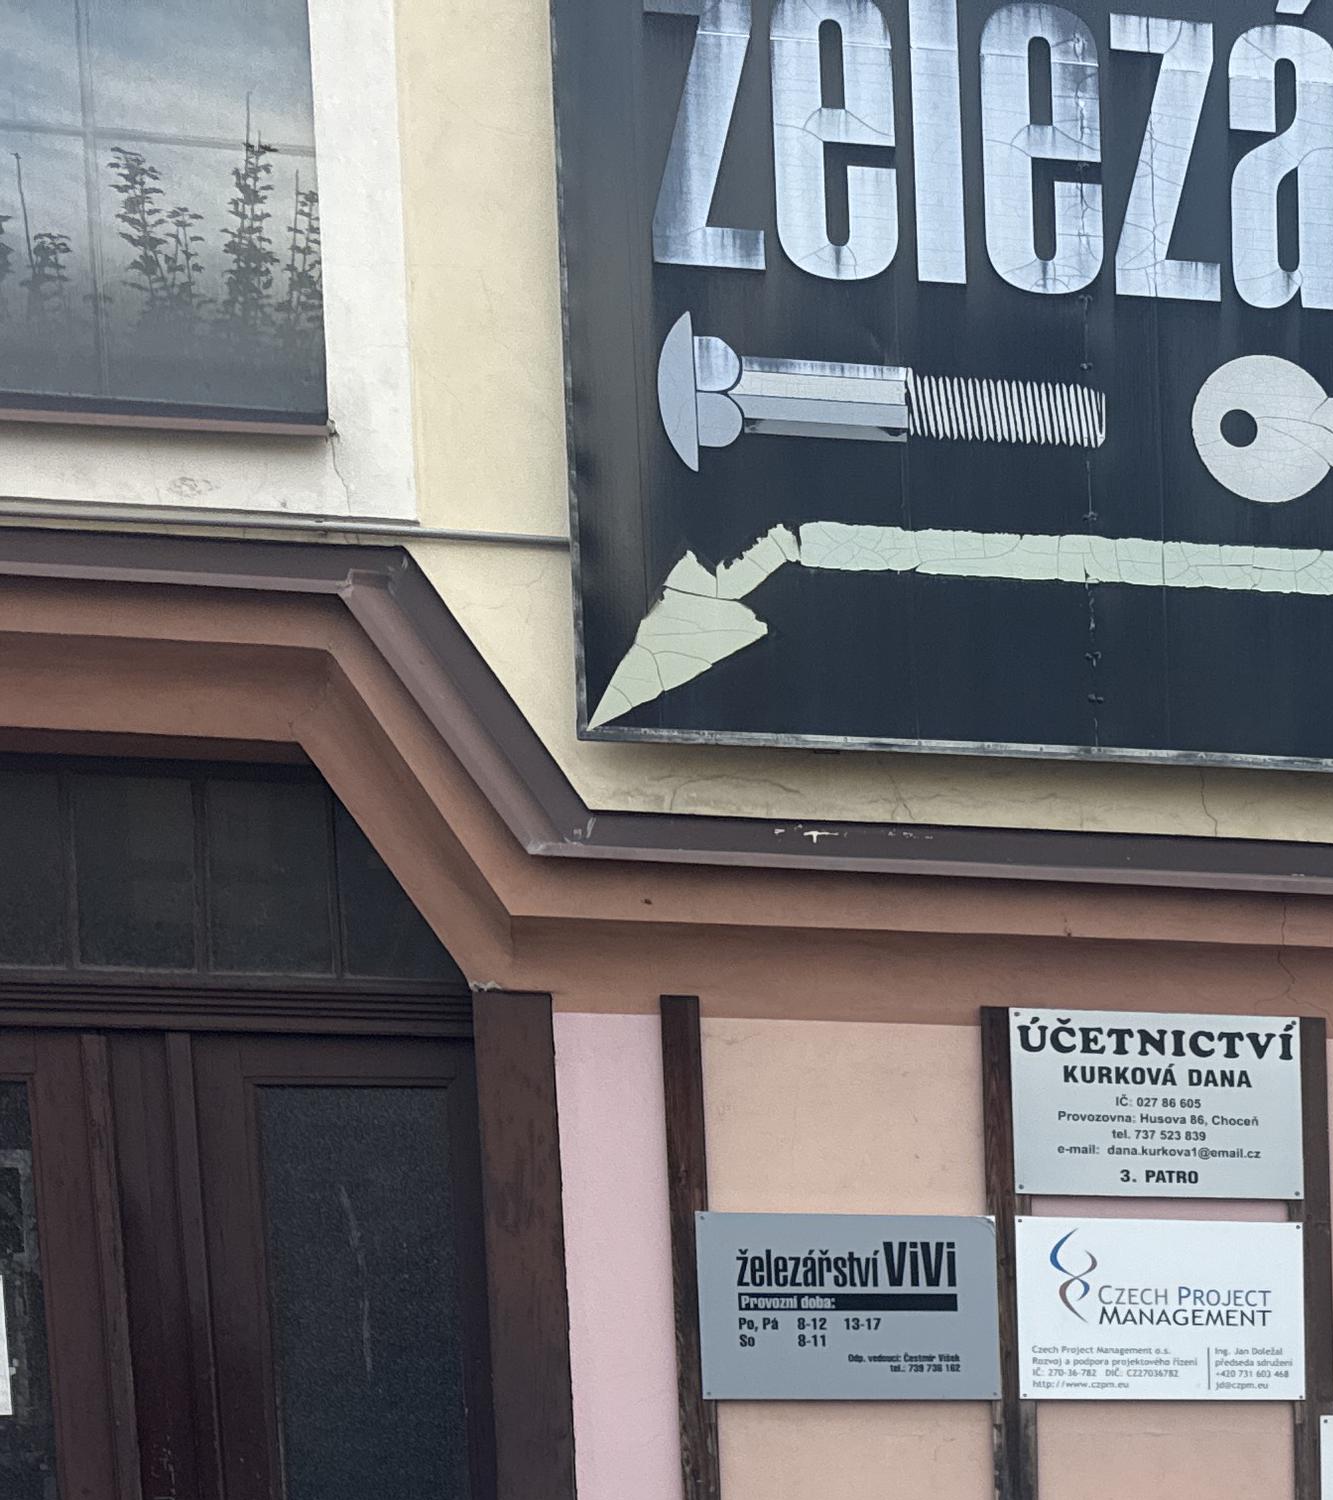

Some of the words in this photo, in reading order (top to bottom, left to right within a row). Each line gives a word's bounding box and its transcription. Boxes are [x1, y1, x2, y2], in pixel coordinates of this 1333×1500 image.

[1017, 1016, 1294, 1061] ÚČETNICTVÍ
[1063, 1063, 1178, 1087] KURKOVÁ
[1188, 1069, 1252, 1088] DANA
[1115, 1096, 1133, 1108] IČ:
[1136, 1097, 1158, 1109] 027
[1161, 1098, 1176, 1109] 86
[1179, 1098, 1202, 1109] 605
[1057, 1111, 1136, 1124] Provozovna:
[1140, 1113, 1187, 1126] Husova
[1190, 1115, 1208, 1128] 86,
[1211, 1113, 1260, 1127] Choceň
[1112, 1129, 1131, 1140] tel.
[1134, 1130, 1156, 1141] 737
[1159, 1130, 1182, 1141] 523
[1185, 1130, 1206, 1142] 839
[1057, 1144, 1100, 1155] e-mail:
[1107, 1145, 1262, 1160] dana.kurkova1@email.cz
[1120, 1169, 1137, 1184] 3.
[1145, 1170, 1200, 1184] PATRO
[736, 1249, 879, 1288] železářství
[882, 1241, 957, 1288] ViVi
[740, 1295, 799, 1310] Provozní
[801, 1296, 836, 1310] doba:
[1098, 1284, 1169, 1306] CZECH
[1177, 1286, 1272, 1308] PROJECT
[1098, 1306, 1272, 1327] MANAGEMENT
[738, 1317, 759, 1333] Po,
[762, 1317, 779, 1331] Pá
[797, 1318, 828, 1331] 8-12
[843, 1317, 882, 1331] 13-17
[739, 1334, 756, 1348] So
[797, 1334, 827, 1348] 8-11
[1031, 1346, 1059, 1354] Czech
[1061, 1345, 1094, 1356] Project
[1096, 1345, 1153, 1356] Management
[1032, 1357, 1062, 1367] Rozvoj
[1073, 1358, 1109, 1367] podpora
